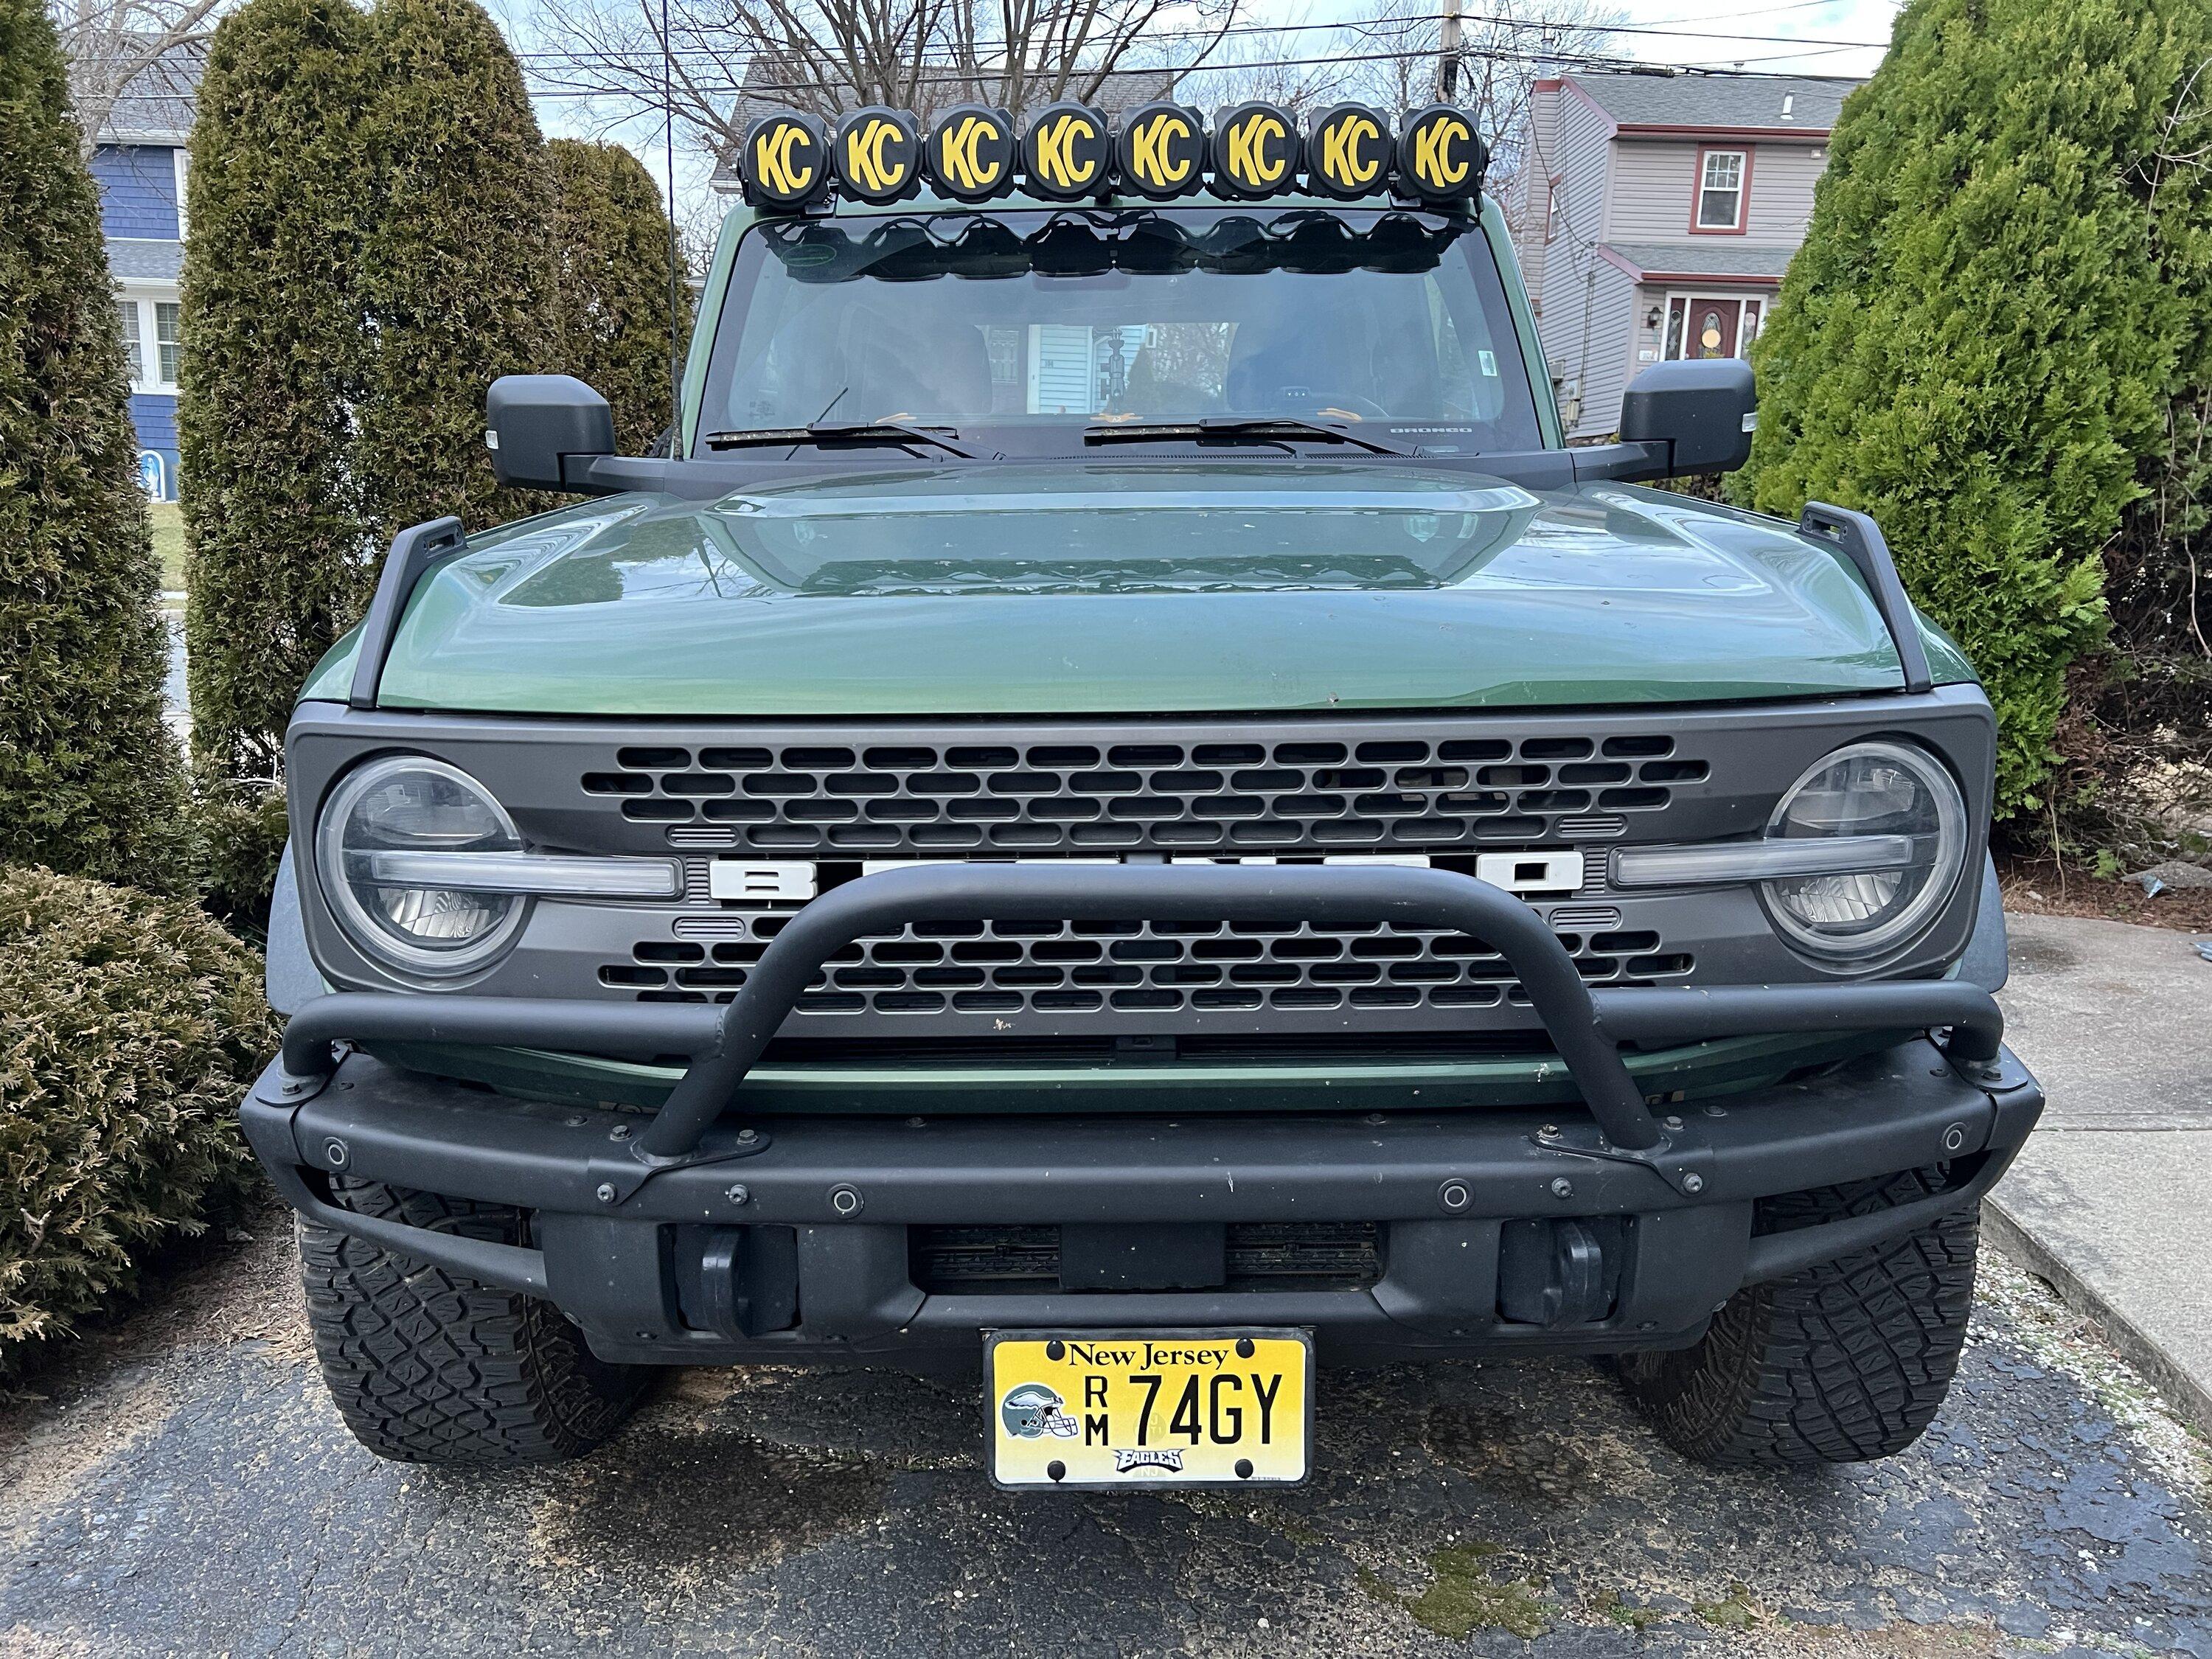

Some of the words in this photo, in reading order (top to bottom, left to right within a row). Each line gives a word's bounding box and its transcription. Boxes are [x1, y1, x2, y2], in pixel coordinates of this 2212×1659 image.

[758, 124, 810, 193] KC
[849, 120, 902, 189] KC
[943, 118, 998, 188] KC
[1039, 116, 1093, 186] KC
[1134, 115, 1189, 185] KC
[1230, 115, 1284, 185] KC
[1325, 116, 1378, 186] KC
[1416, 118, 1468, 187] KC
[1068, 1343, 1135, 1366] New
[1140, 1343, 1229, 1371] Jersey
[1130, 1374, 1282, 1446] 74GY
[1116, 1449, 1183, 1472] EAGLES
